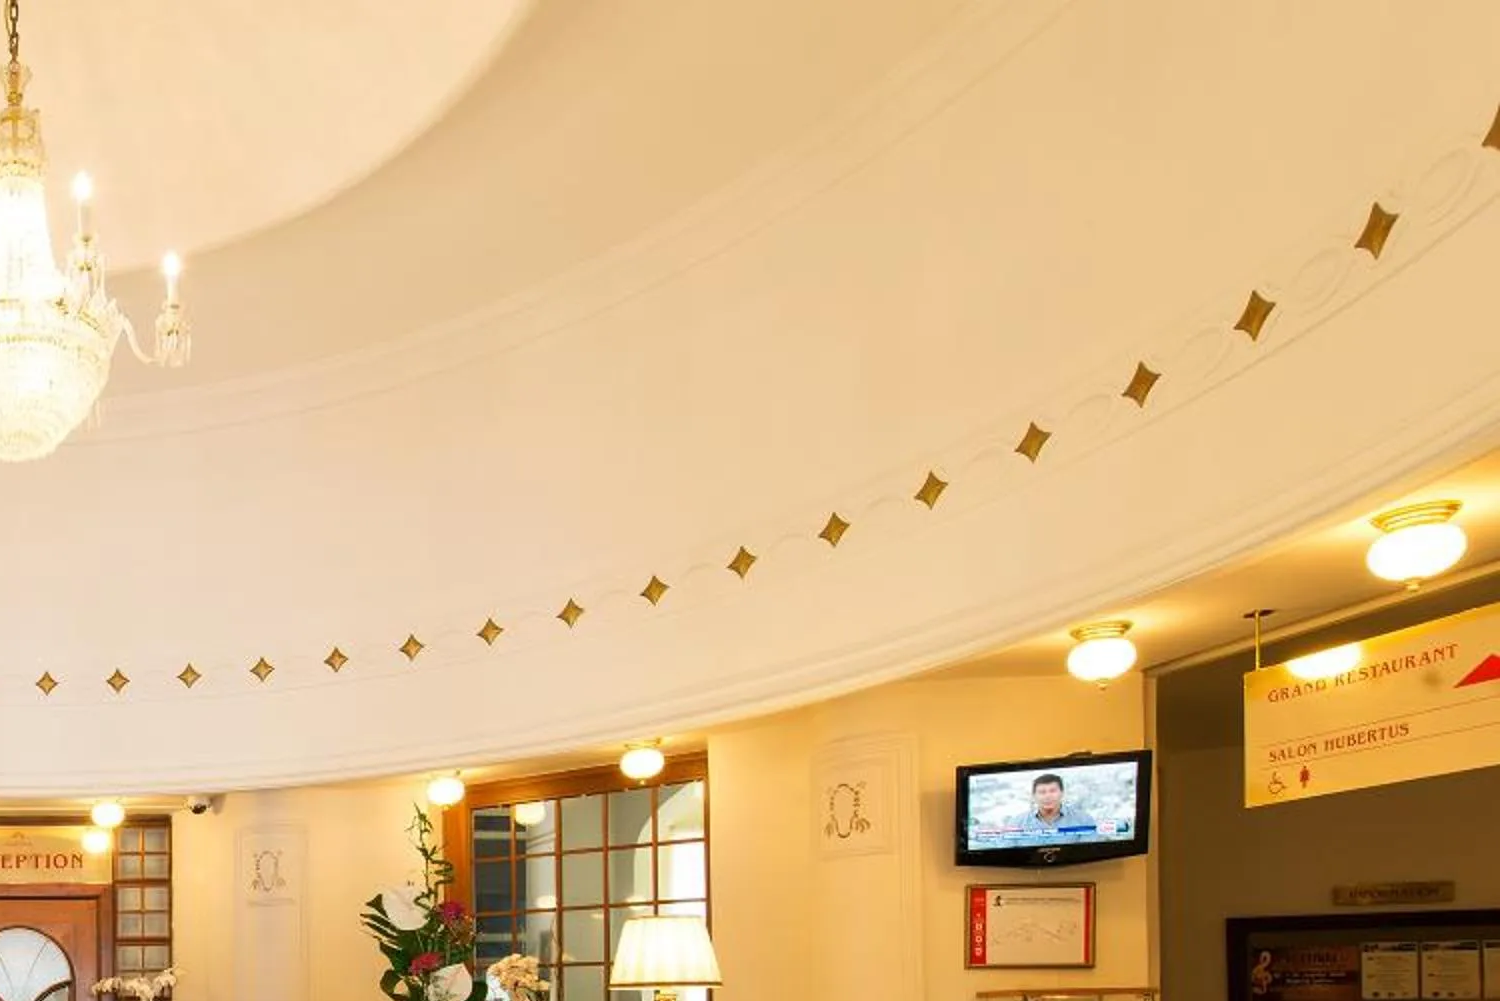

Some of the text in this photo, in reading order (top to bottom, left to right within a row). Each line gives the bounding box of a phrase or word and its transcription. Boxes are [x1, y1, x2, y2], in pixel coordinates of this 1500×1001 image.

[1267, 643, 1459, 703] GRAND RESTAURANT
[1267, 722, 1410, 763] SALON HUBERTUS
